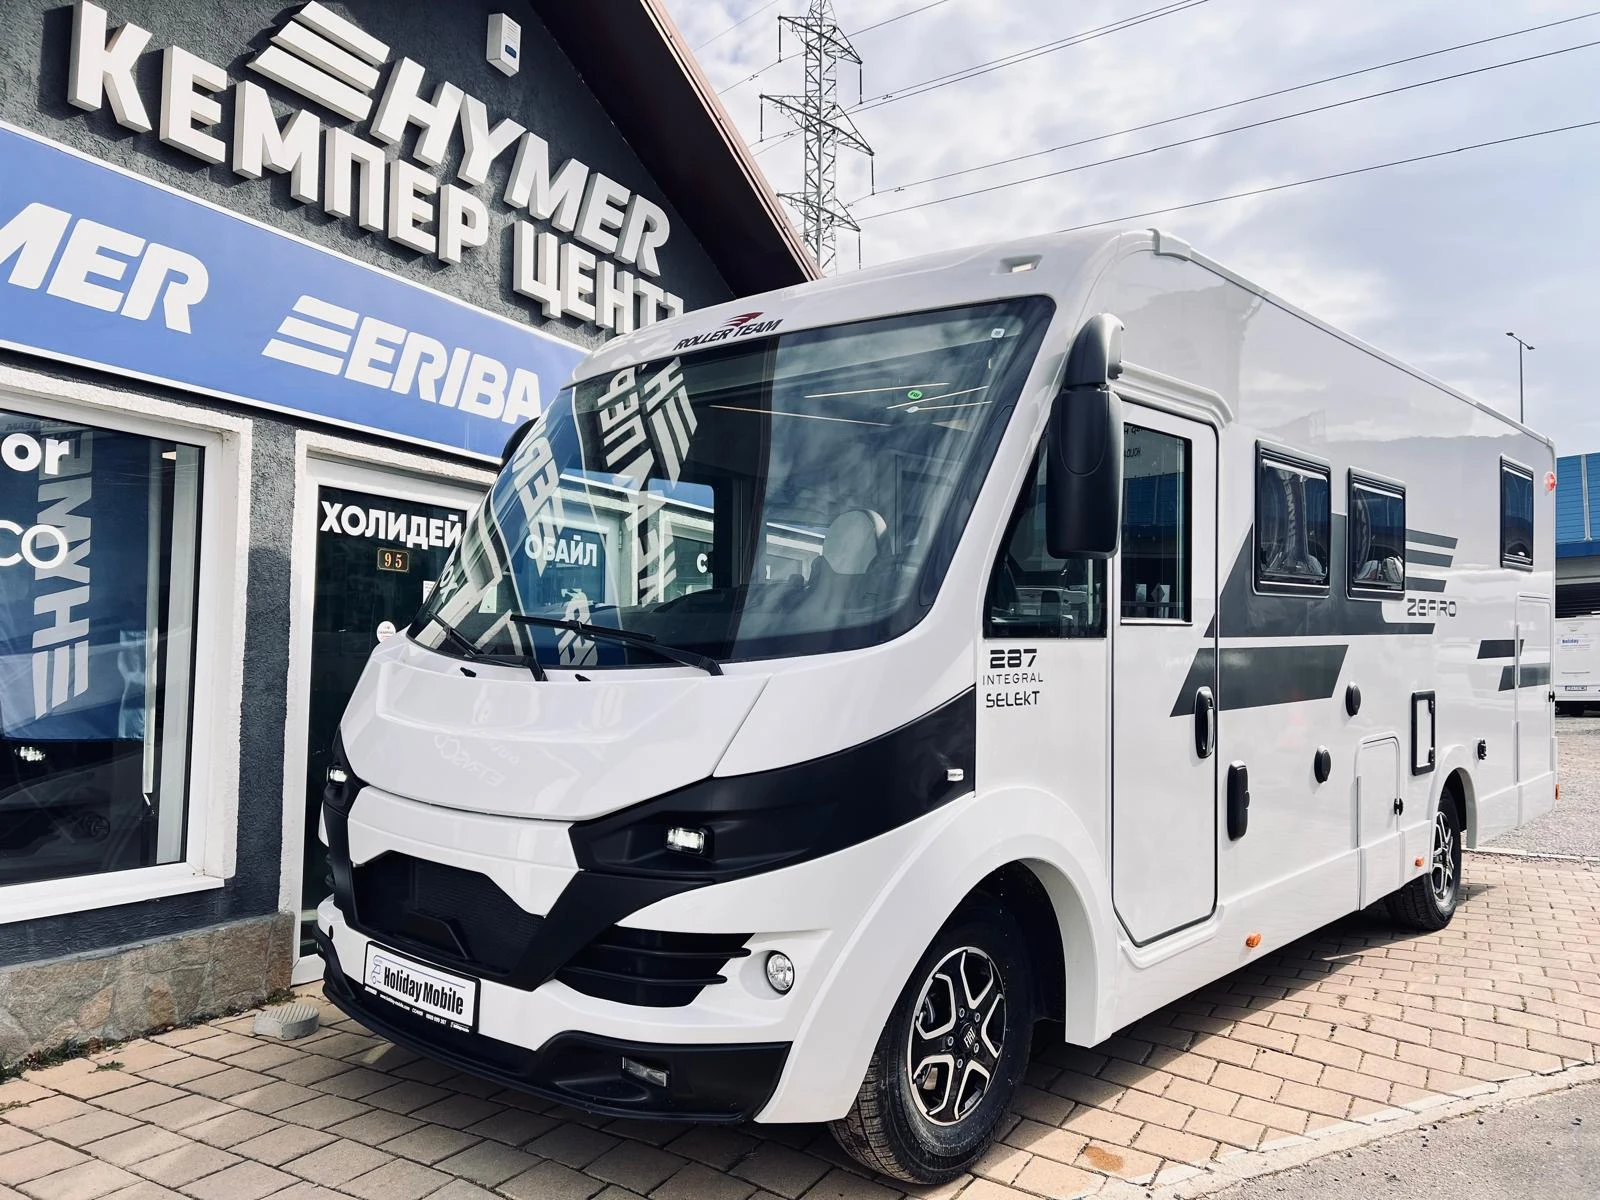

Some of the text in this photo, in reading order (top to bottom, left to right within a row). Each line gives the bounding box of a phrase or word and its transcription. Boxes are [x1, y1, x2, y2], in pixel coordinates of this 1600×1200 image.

[67, 0, 489, 264] КЕМПЕР
[369, 56, 671, 276] HYMER
[672, 318, 784, 351] ROLLER TEAM
[344, 314, 542, 425] ERIBA
[1, 432, 70, 476] or
[320, 501, 463, 550] ХОЛИДЕЙ
[983, 672, 1044, 686] INTEGRAL
[990, 648, 1038, 669] 287
[383, 966, 423, 1003] Holiday
[422, 981, 464, 1016] Mobile
[964, 1026, 976, 1048] FIAT
